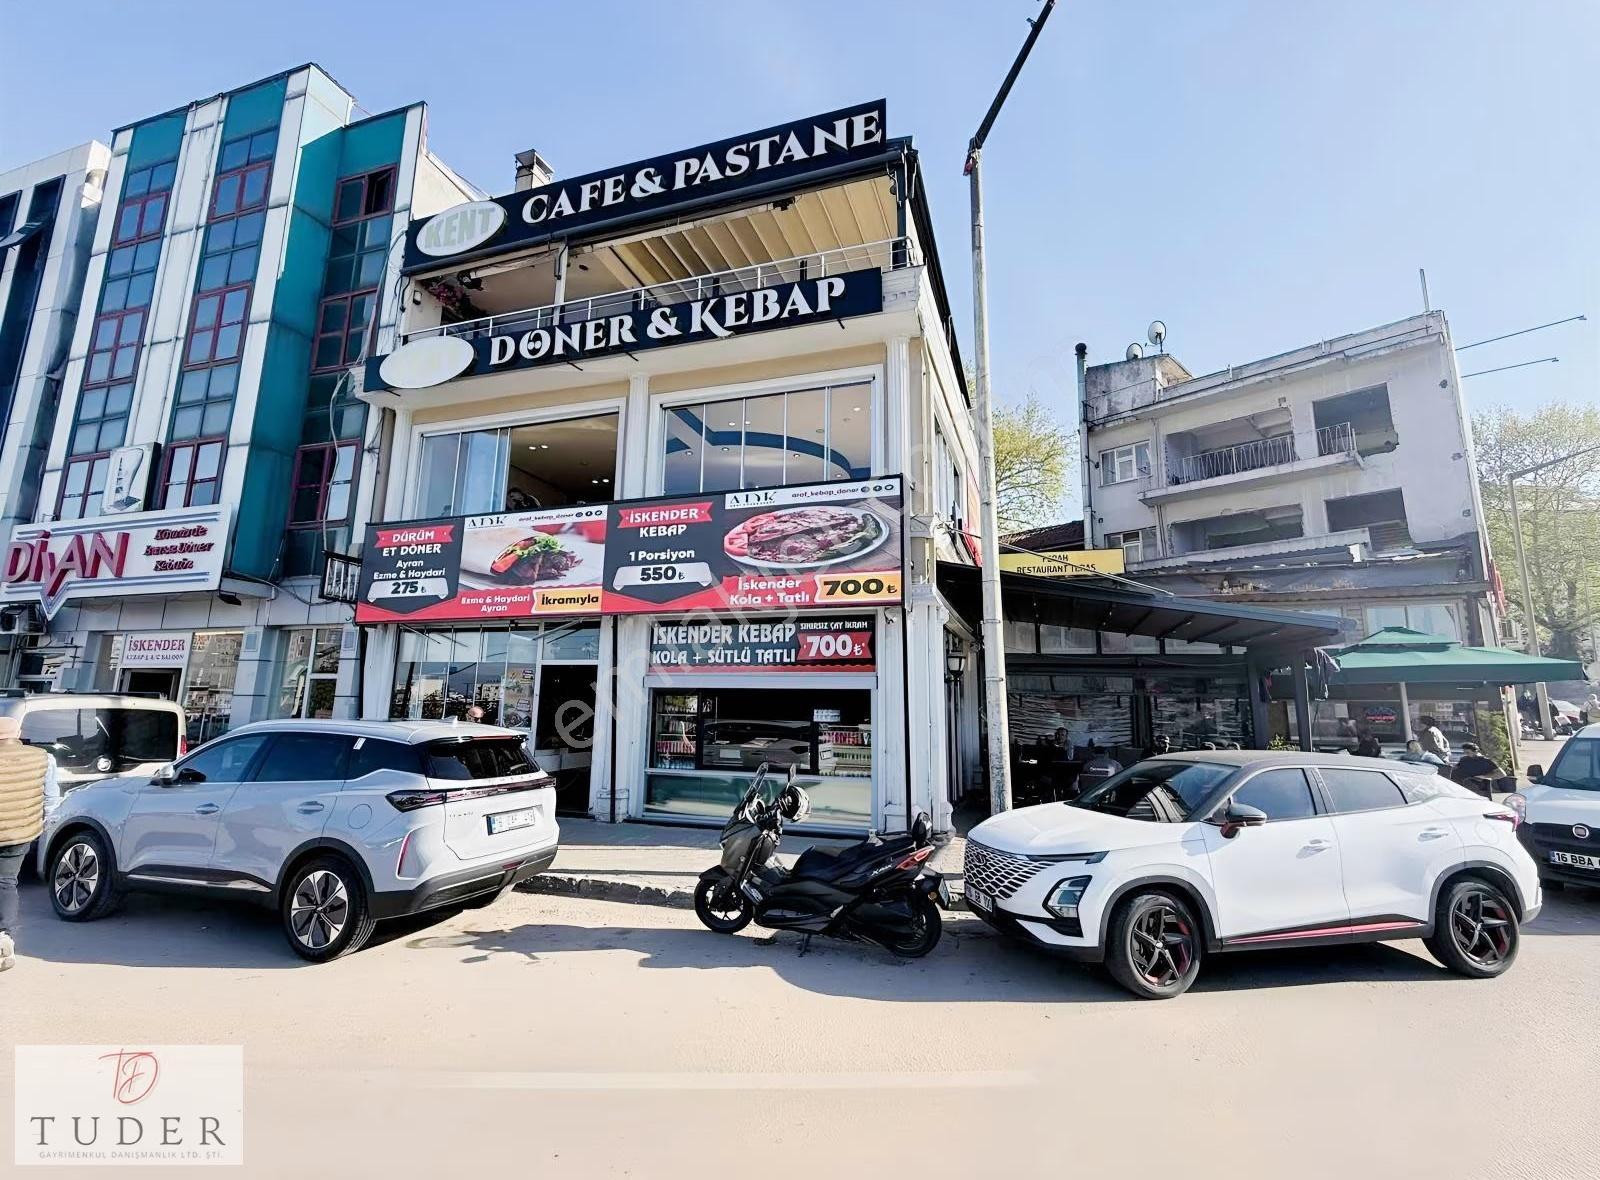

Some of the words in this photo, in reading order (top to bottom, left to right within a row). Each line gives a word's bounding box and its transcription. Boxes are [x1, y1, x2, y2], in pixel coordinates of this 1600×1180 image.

[424, 207, 496, 249] KENT
[647, 302, 682, 338] &
[690, 278, 846, 337] KEBAP
[628, 507, 699, 524] İSKENDER
[392, 531, 435, 543] DÜRÜM
[639, 524, 687, 538] KEBAP
[382, 547, 398, 557] ET
[400, 543, 441, 555] DÖNER
[629, 551, 634, 561] 1
[637, 549, 695, 562] Porsiyon
[3, 529, 130, 598] DİVAN
[396, 559, 424, 569] Ayran
[1016, 565, 1068, 574] RESTAURANT
[373, 571, 397, 580] Ezme
[399, 569, 407, 580] &
[409, 567, 446, 578] Haydari
[738, 577, 802, 591] İskender
[496, 594, 530, 605] Haydari
[542, 592, 599, 607] İkramıyla
[729, 592, 762, 606] Kola
[776, 590, 809, 603] Tatlı
[481, 604, 508, 613] Ayran
[653, 623, 732, 645] İSKENDER
[738, 622, 796, 644] KEBAP
[830, 622, 844, 631] ÇAY
[129, 636, 185, 652] İSKENDER
[652, 650, 687, 665] KOLA
[707, 647, 751, 664] SÜTLÜ
[756, 647, 796, 664] TATLI
[1556, 852, 1568, 863] 16
[1570, 855, 1594, 866] BBA
